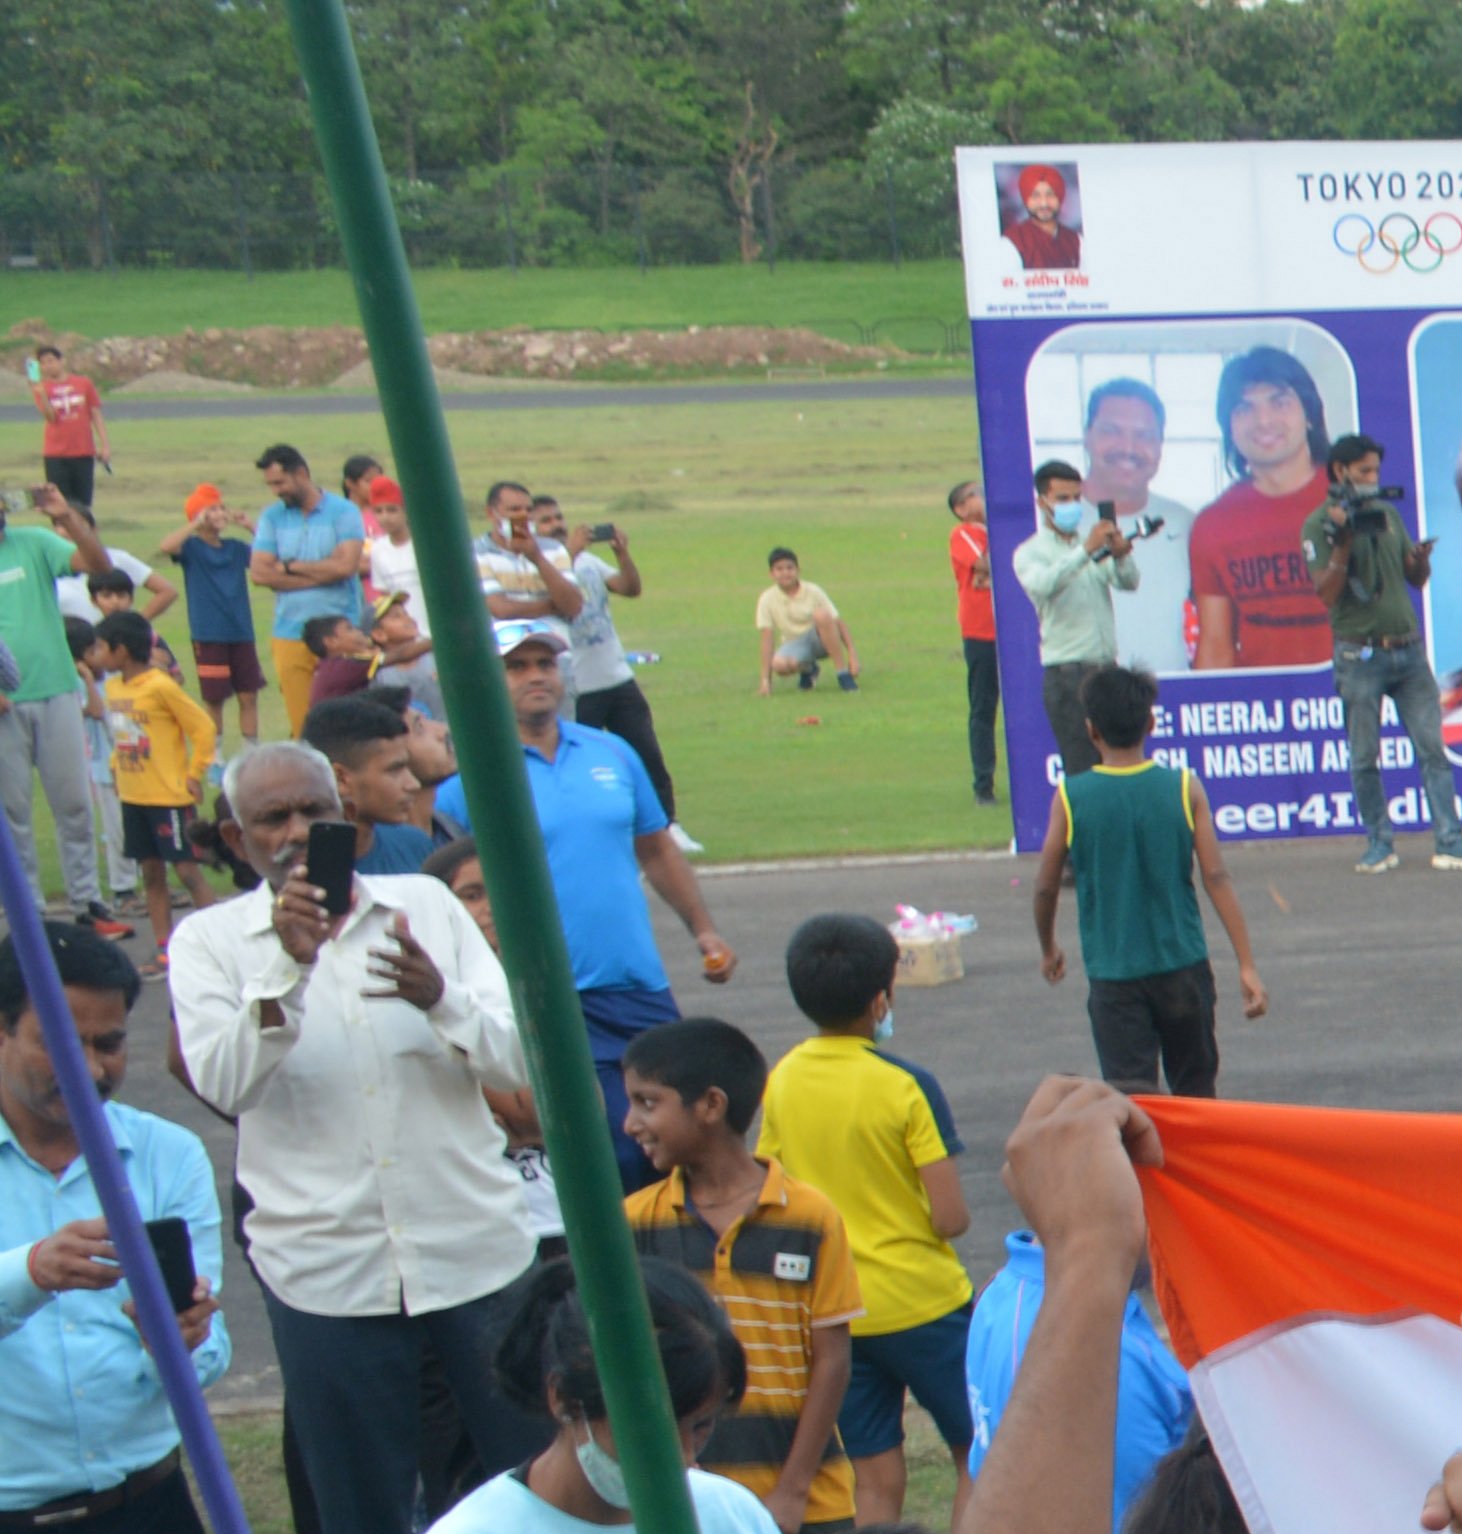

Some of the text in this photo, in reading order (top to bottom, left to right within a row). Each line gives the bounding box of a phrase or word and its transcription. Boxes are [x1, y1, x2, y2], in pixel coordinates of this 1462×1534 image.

[1297, 172, 1406, 201] TOKYO
[1228, 552, 1312, 590] SUPER
[1180, 698, 1284, 737] NEERAJ
[1291, 694, 1400, 732] CHOA
[1203, 740, 1314, 778] NASEEM
[1321, 735, 1414, 773] AHED
